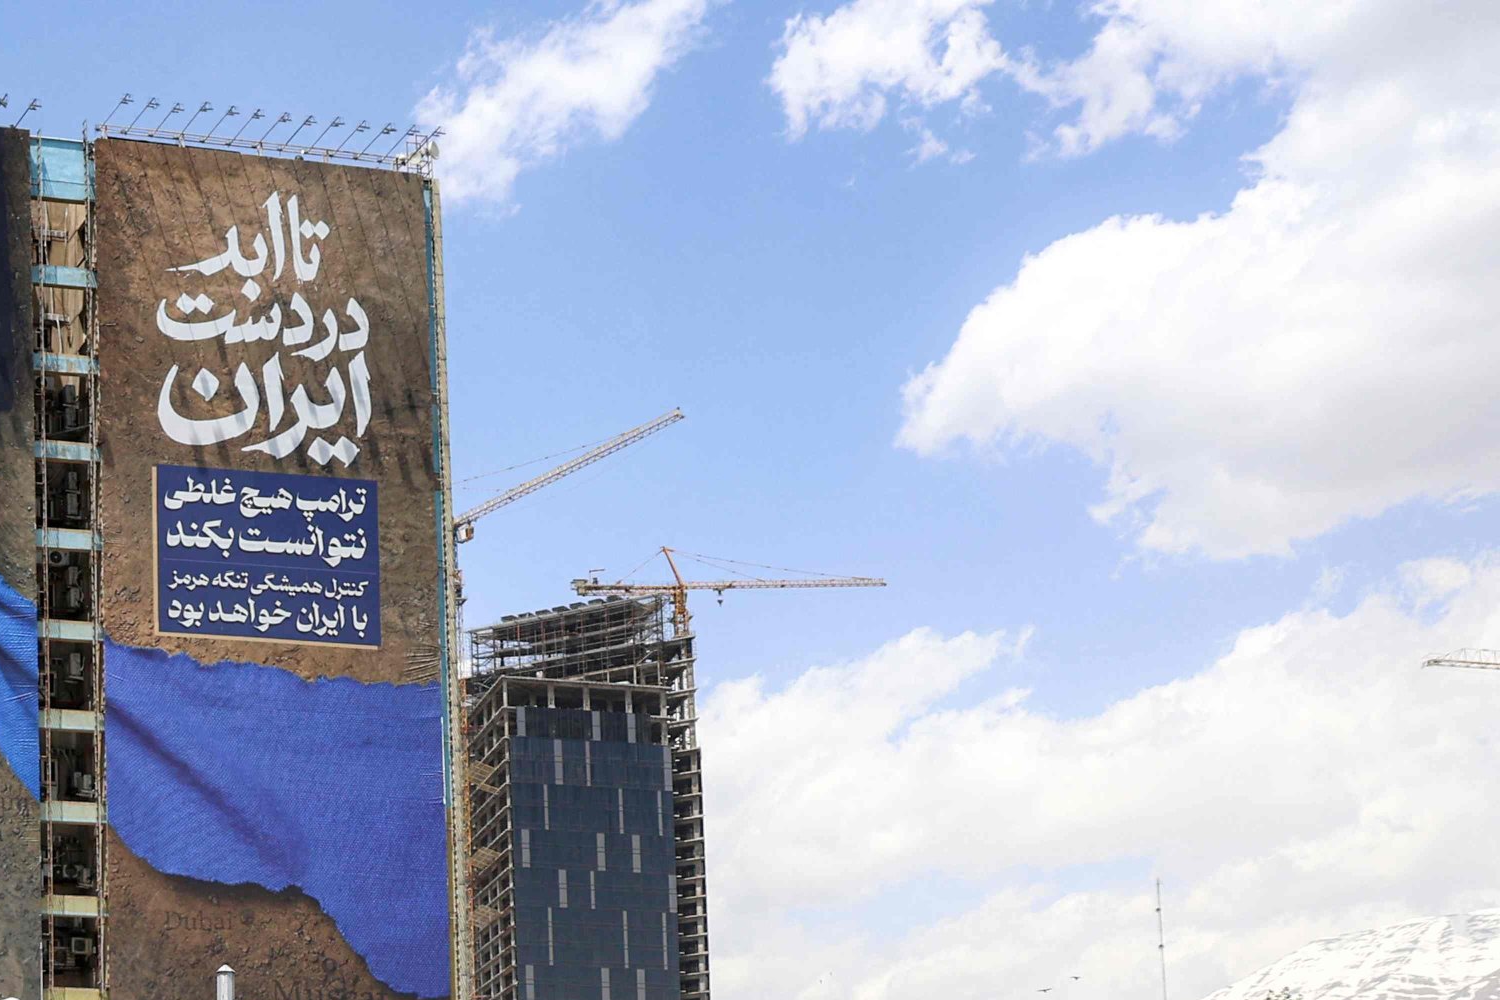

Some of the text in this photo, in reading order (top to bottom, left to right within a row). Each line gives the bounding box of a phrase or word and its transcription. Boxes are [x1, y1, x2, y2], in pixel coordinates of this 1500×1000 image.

[164, 191, 329, 300] تا ابد
[156, 292, 369, 361] در دست
[157, 350, 371, 467] ایران
[164, 475, 367, 522] ترامپ هیچ غلطی
[166, 519, 367, 567] نتوانست بکند
[166, 570, 369, 600] کنترل همیشگی تنگه هرمز
[167, 595, 369, 638] با ایران خواهد بود
[165, 910, 232, 931] Dubai
